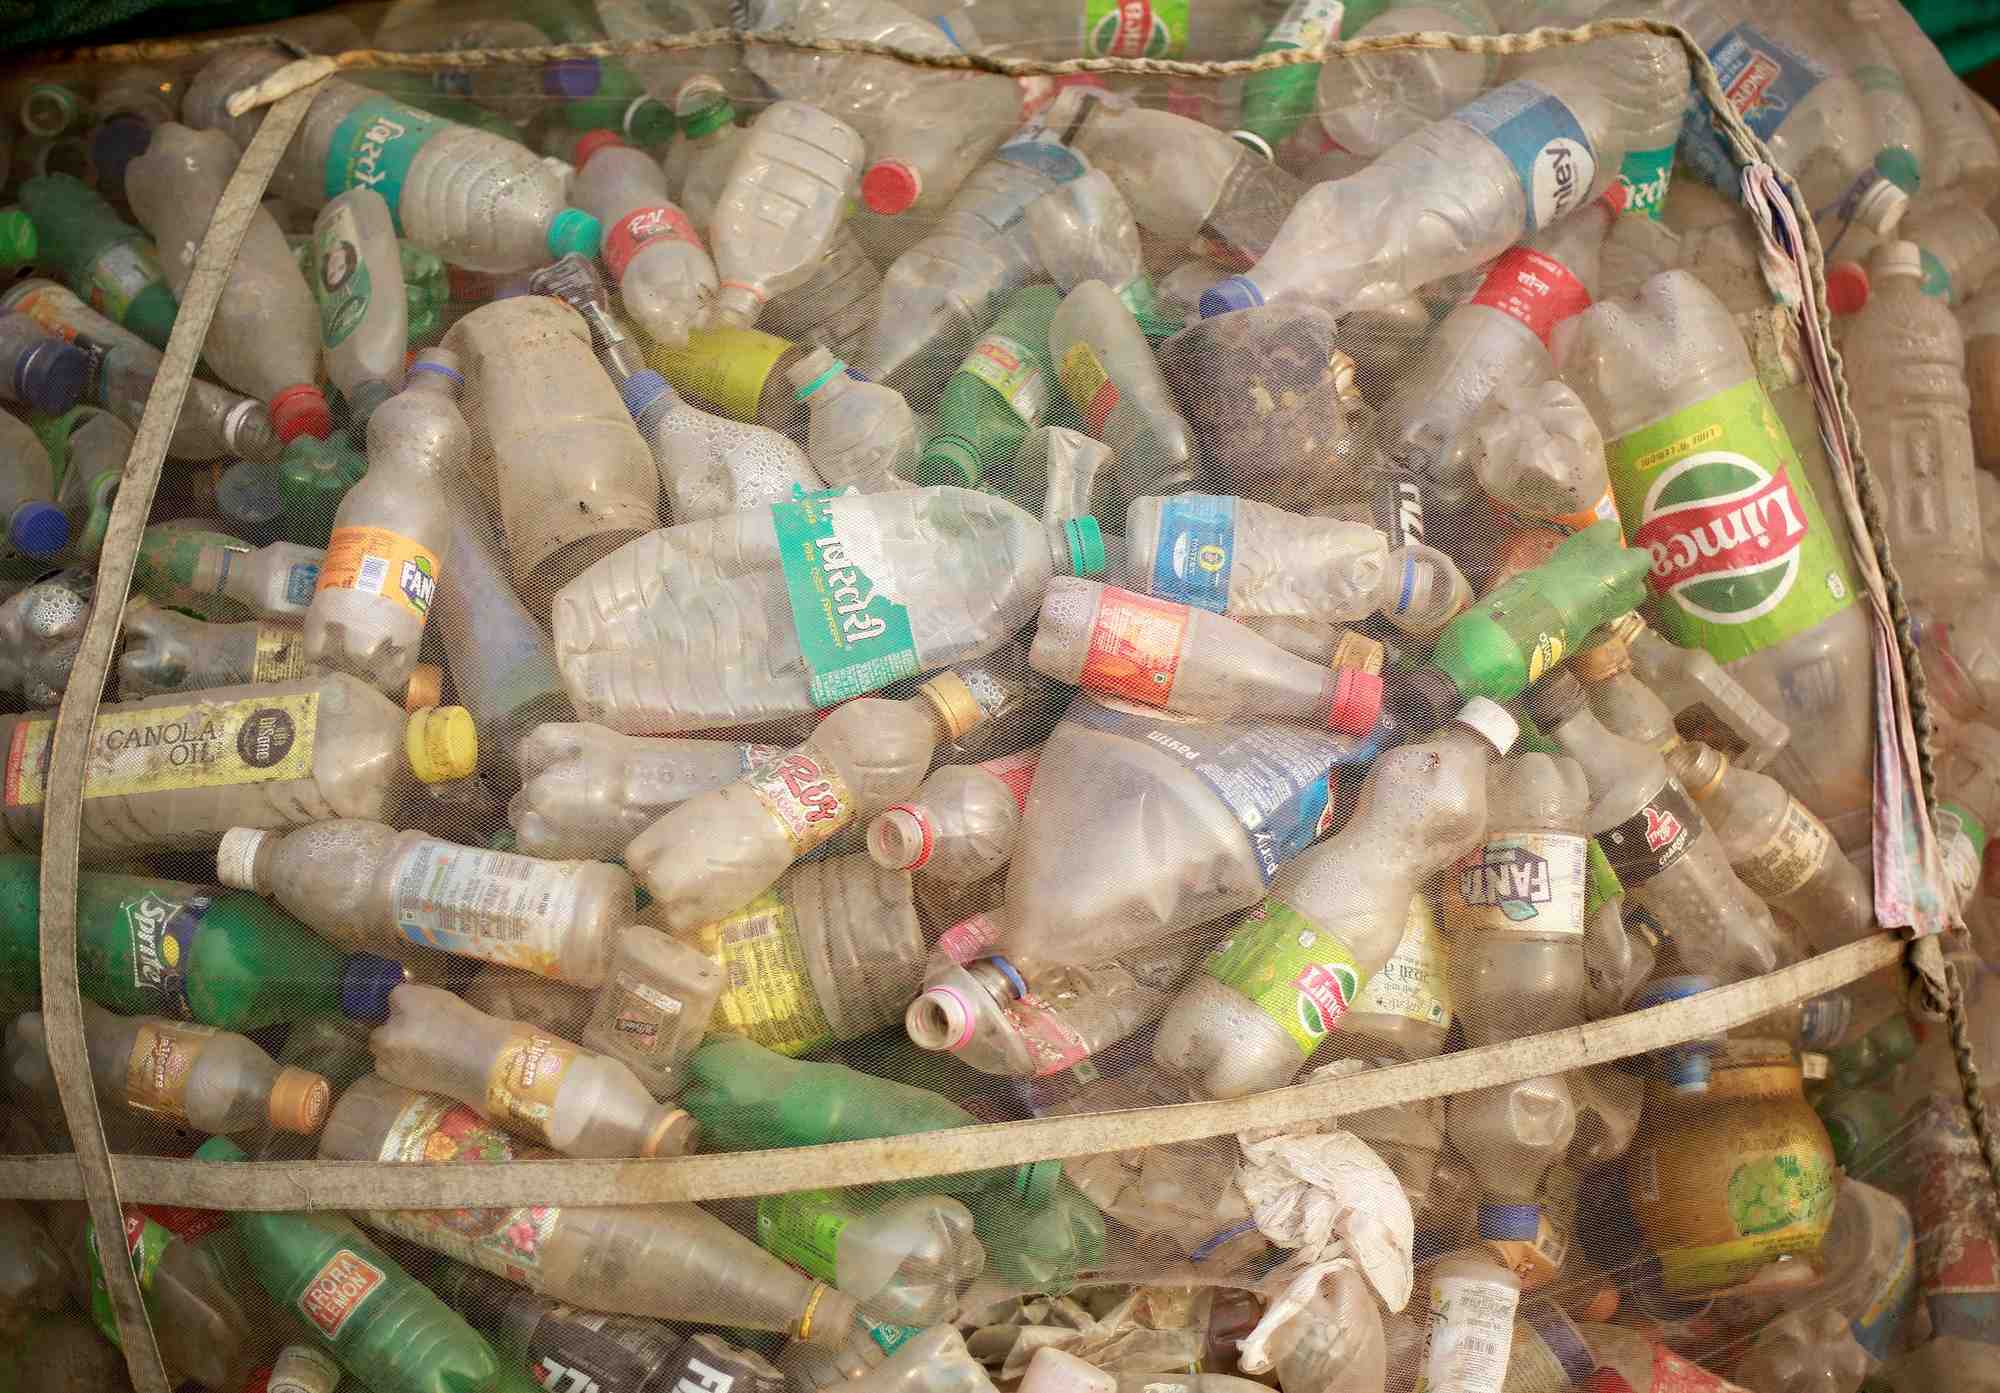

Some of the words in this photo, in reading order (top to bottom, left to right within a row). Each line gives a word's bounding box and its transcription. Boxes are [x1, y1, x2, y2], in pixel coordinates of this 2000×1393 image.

[1648, 482, 1803, 570] Limca
[104, 722, 219, 753] CANOLA
[169, 737, 216, 767] OIL
